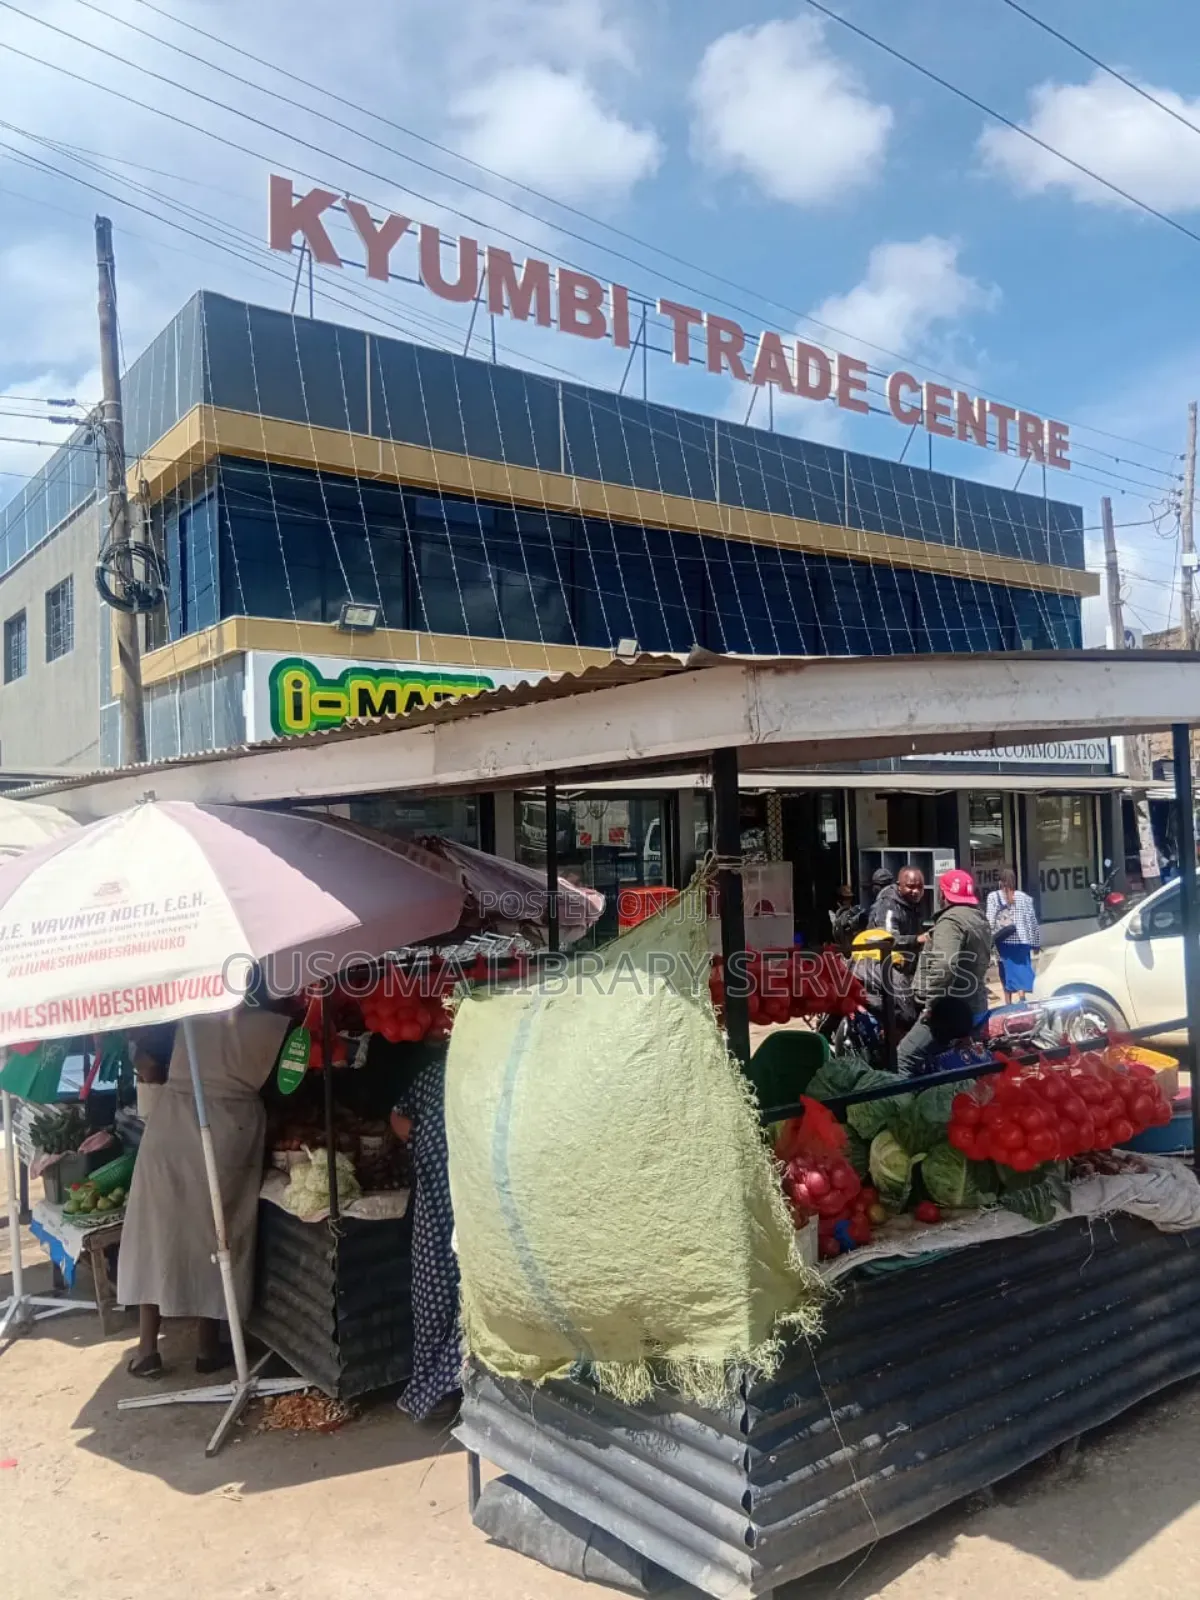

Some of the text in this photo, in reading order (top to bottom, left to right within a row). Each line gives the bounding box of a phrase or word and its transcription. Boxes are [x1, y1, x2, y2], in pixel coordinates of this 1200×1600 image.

[267, 173, 1071, 470] KYUMBI TRADE CENTRE
[291, 679, 468, 721] i-MA
[985, 743, 1105, 760] ACCOMMODATION
[31, 910, 105, 936] WAVINYA
[164, 892, 207, 912] E.G.H.
